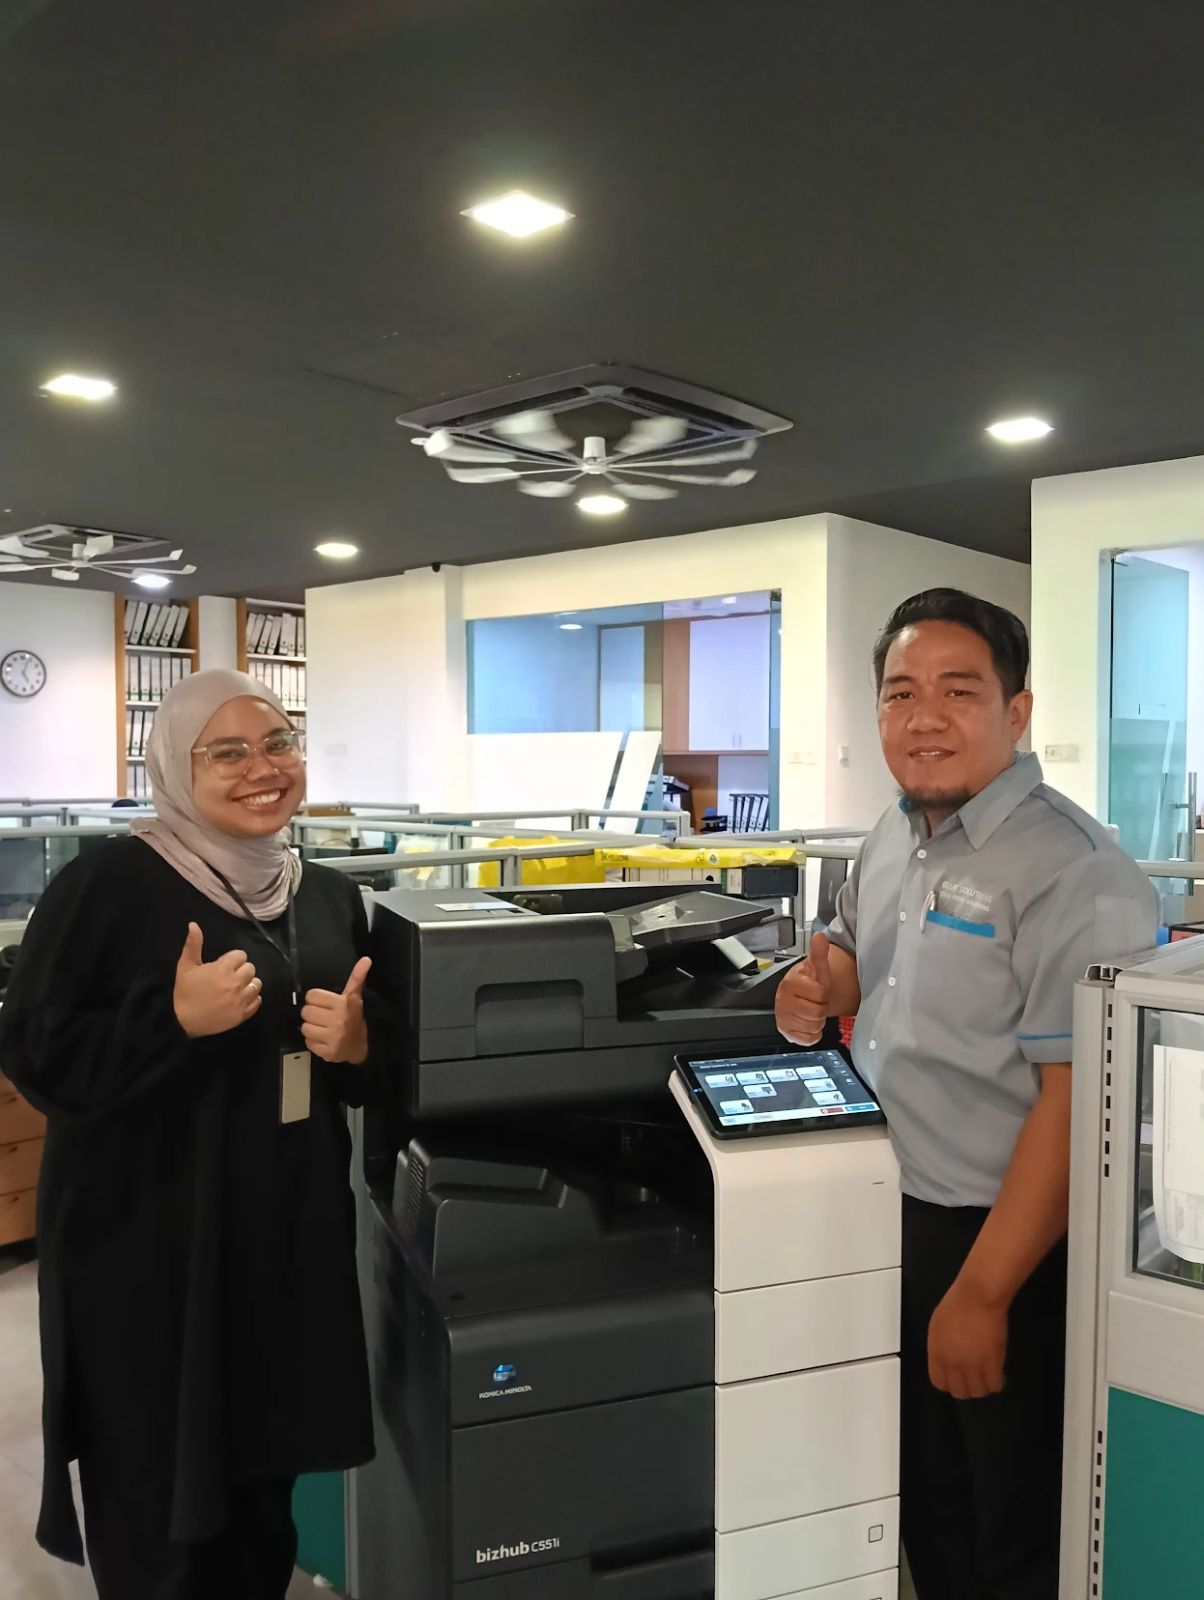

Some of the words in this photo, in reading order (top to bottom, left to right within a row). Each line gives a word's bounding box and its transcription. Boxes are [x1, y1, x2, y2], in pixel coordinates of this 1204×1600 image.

[479, 1389, 504, 1399] KONICA
[504, 1385, 532, 1395] MINOLTA
[476, 1541, 530, 1563] bizhub
[531, 1537, 560, 1552] C551i
